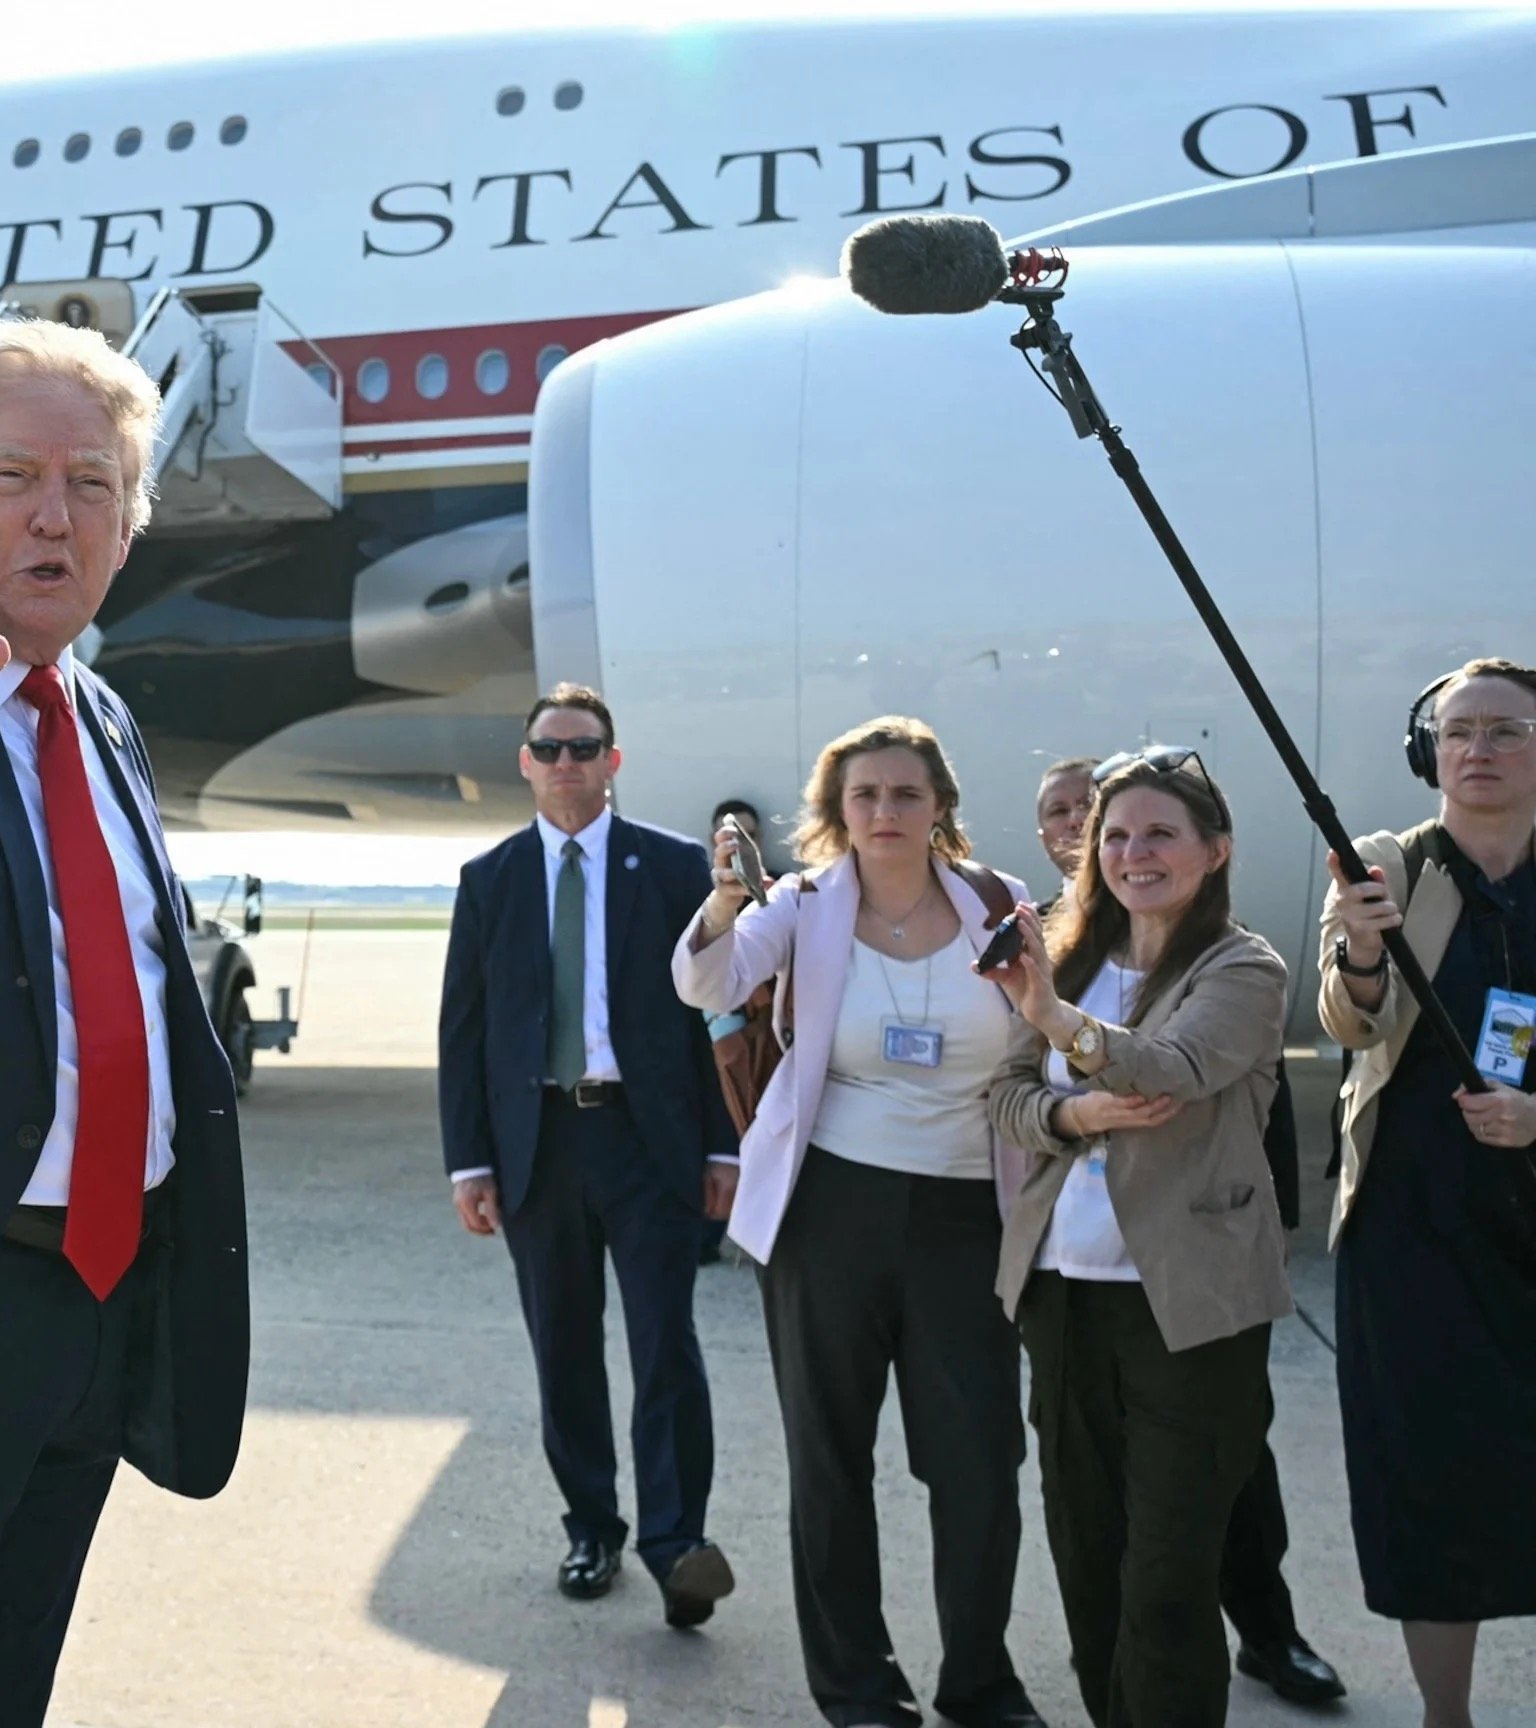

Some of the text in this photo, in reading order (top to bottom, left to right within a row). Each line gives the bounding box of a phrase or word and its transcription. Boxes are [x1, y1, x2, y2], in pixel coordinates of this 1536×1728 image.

[362, 122, 1072, 259] STATES
[1181, 84, 1448, 180] OF
[1492, 1056, 1507, 1070] P
